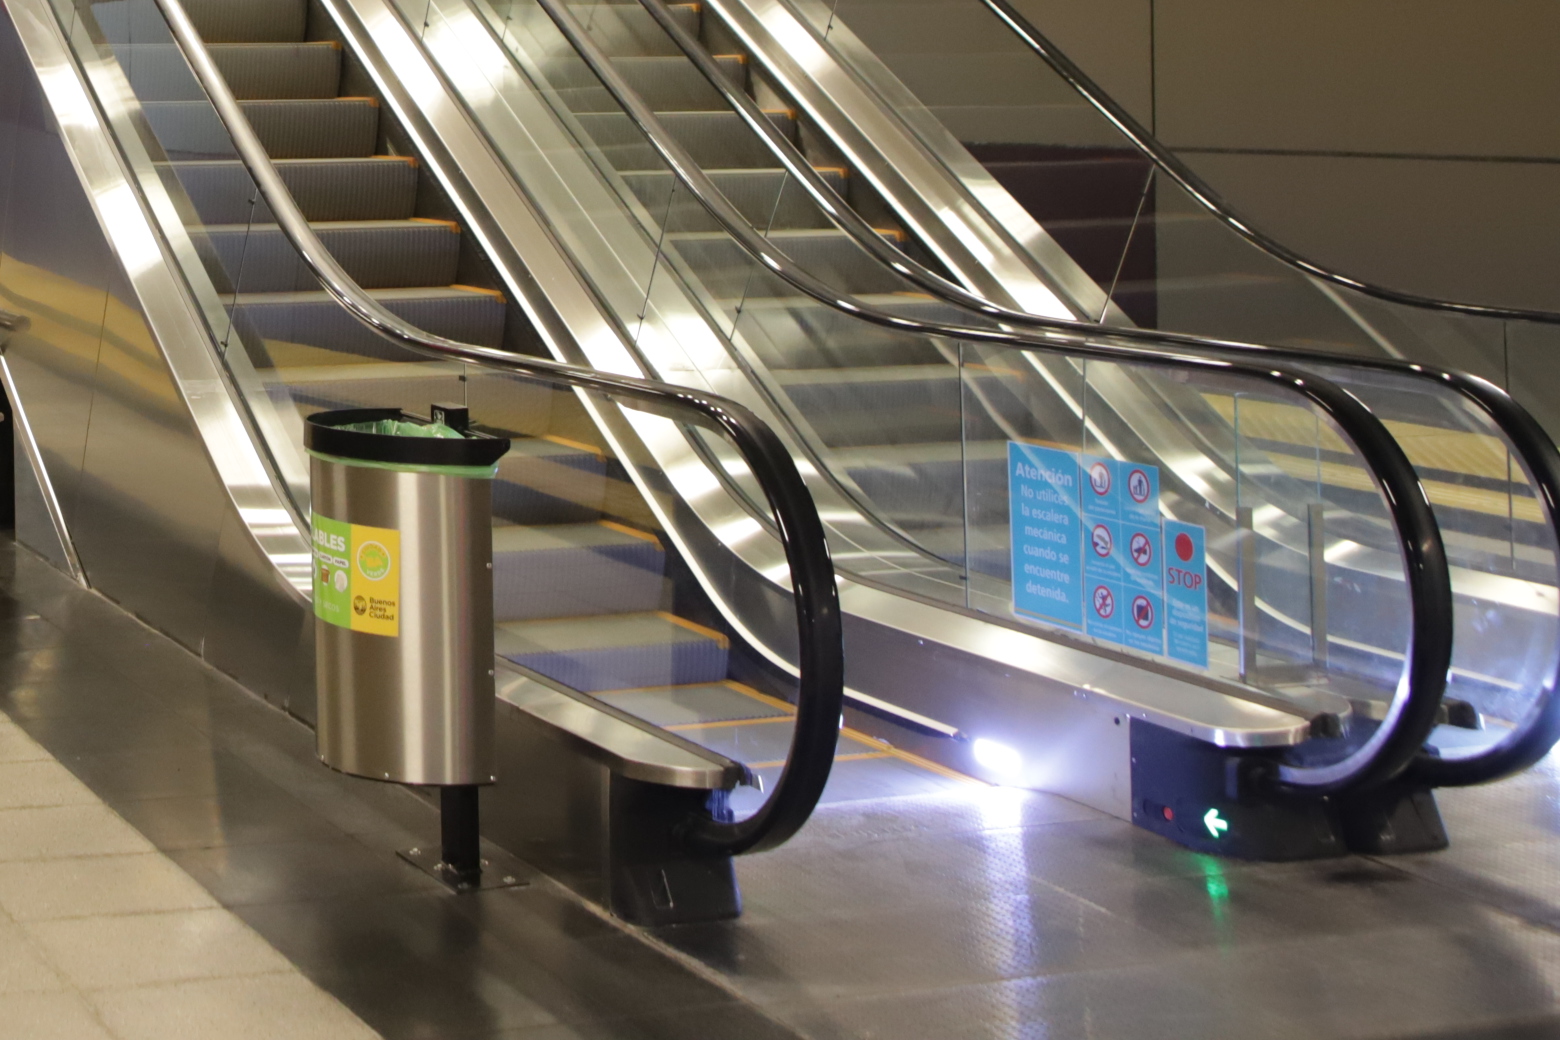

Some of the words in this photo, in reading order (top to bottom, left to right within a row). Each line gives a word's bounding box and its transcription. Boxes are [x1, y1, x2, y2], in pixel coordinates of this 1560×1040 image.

[1015, 462, 1073, 487] Atención
[1021, 484, 1034, 499] No
[1036, 488, 1069, 506] utilices
[1022, 503, 1030, 517] la
[1032, 507, 1069, 526] escalera
[1025, 525, 1067, 545] mecánica
[1023, 544, 1057, 562] cuando
[1058, 552, 1069, 564] se
[1024, 563, 1070, 584] encuentre
[1168, 567, 1203, 590] STOP
[369, 597, 396, 607] Buenos
[1026, 580, 1069, 603] detenida.
[369, 605, 387, 613] Aires
[369, 611, 395, 621] Ciudad
